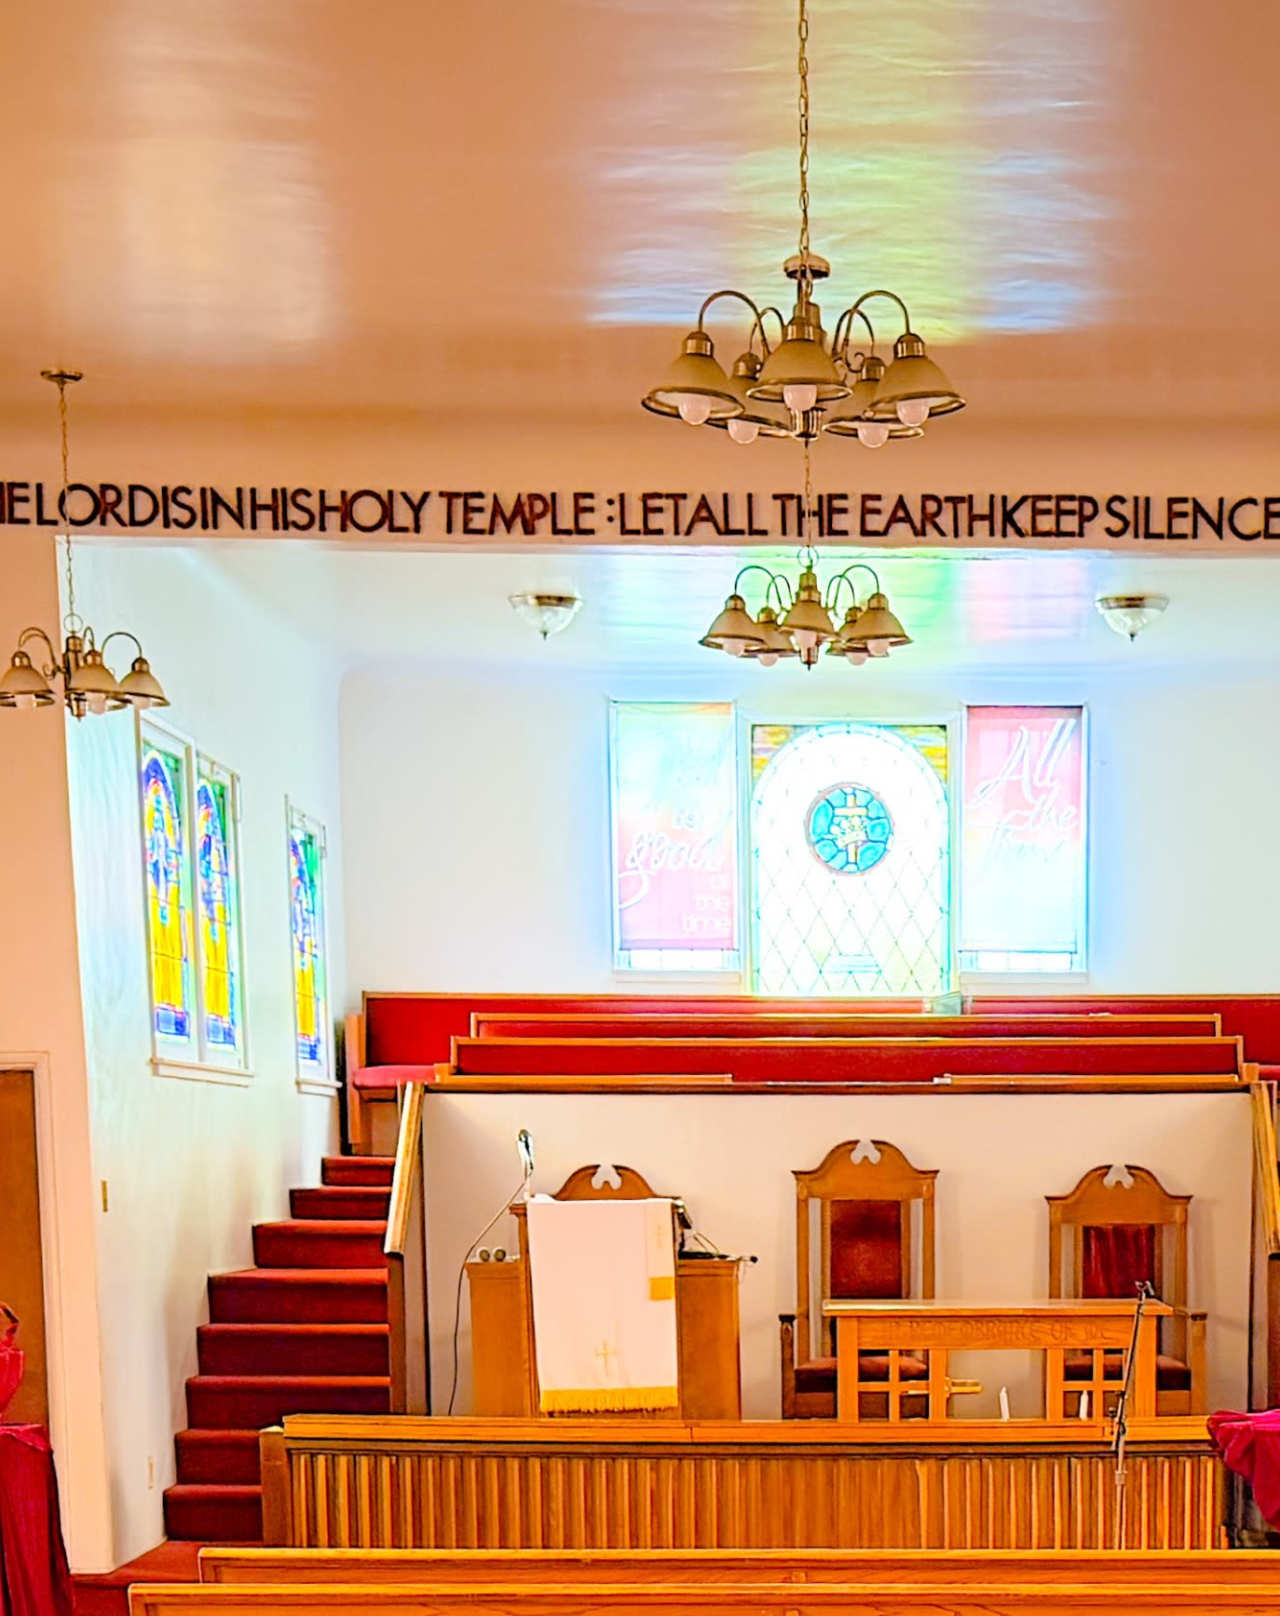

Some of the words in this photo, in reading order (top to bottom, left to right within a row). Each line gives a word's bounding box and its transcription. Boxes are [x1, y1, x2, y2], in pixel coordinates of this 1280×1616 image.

[318, 488, 431, 534] HOLY
[772, 493, 849, 538] THE
[860, 494, 995, 539] EARTH
[1001, 494, 1099, 539] KEEP
